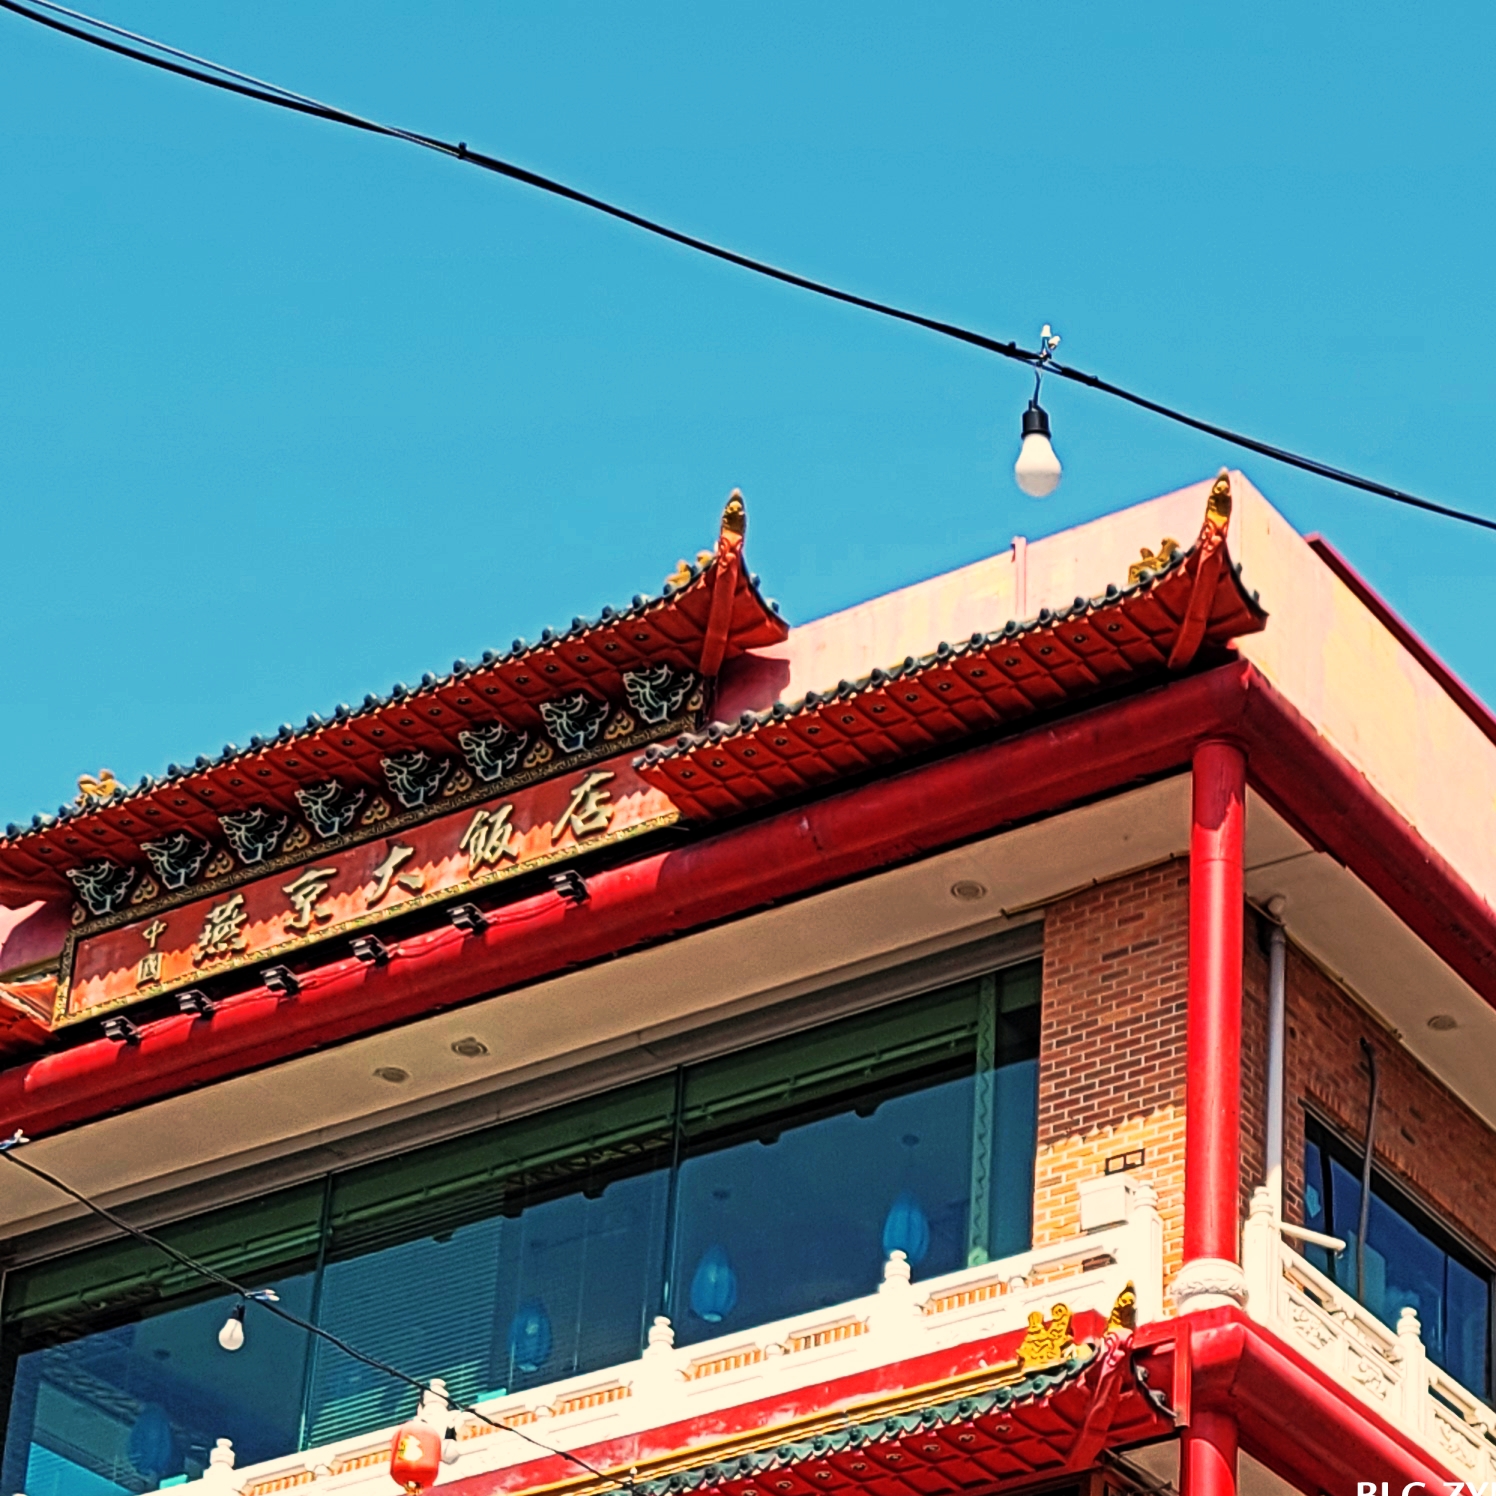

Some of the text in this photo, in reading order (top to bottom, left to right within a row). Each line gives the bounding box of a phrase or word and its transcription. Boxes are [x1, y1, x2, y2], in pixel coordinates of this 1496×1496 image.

[193, 771, 617, 961] 燕京大飯店
